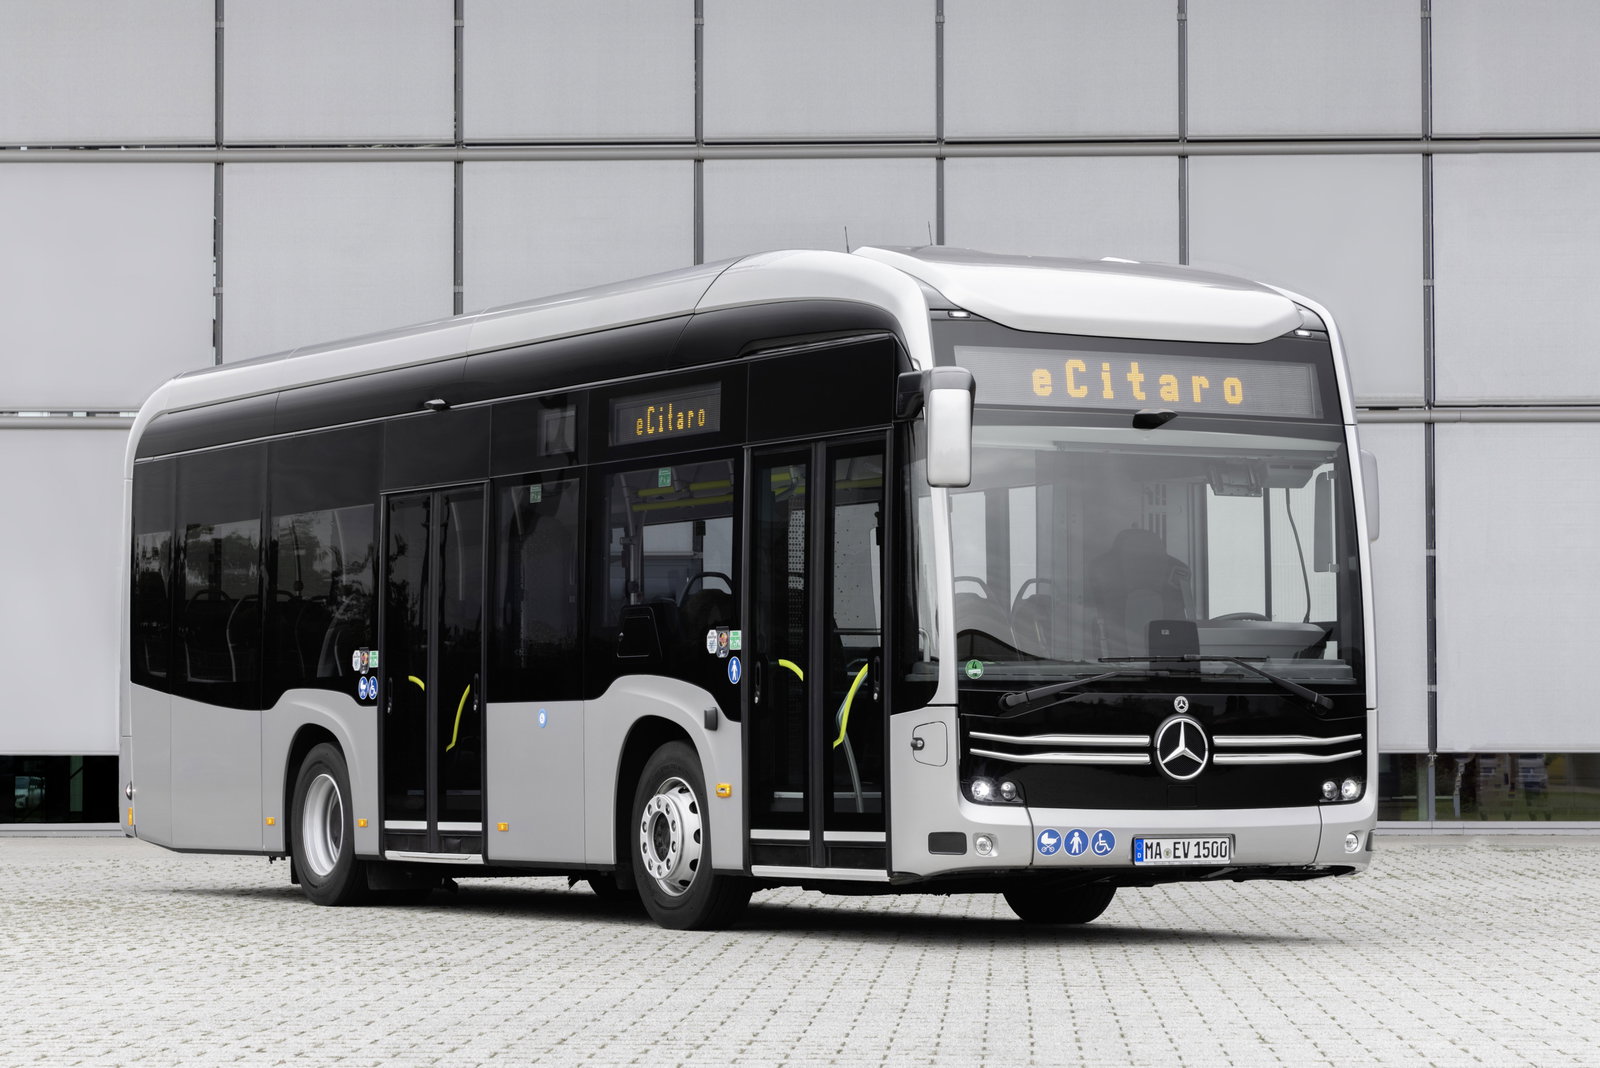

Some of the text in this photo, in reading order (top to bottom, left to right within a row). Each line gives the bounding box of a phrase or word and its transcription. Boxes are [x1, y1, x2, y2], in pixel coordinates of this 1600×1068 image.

[1032, 359, 1243, 404] eCitaro
[636, 403, 705, 435] eCitaro
[1145, 841, 1227, 859] MA EV 1500
